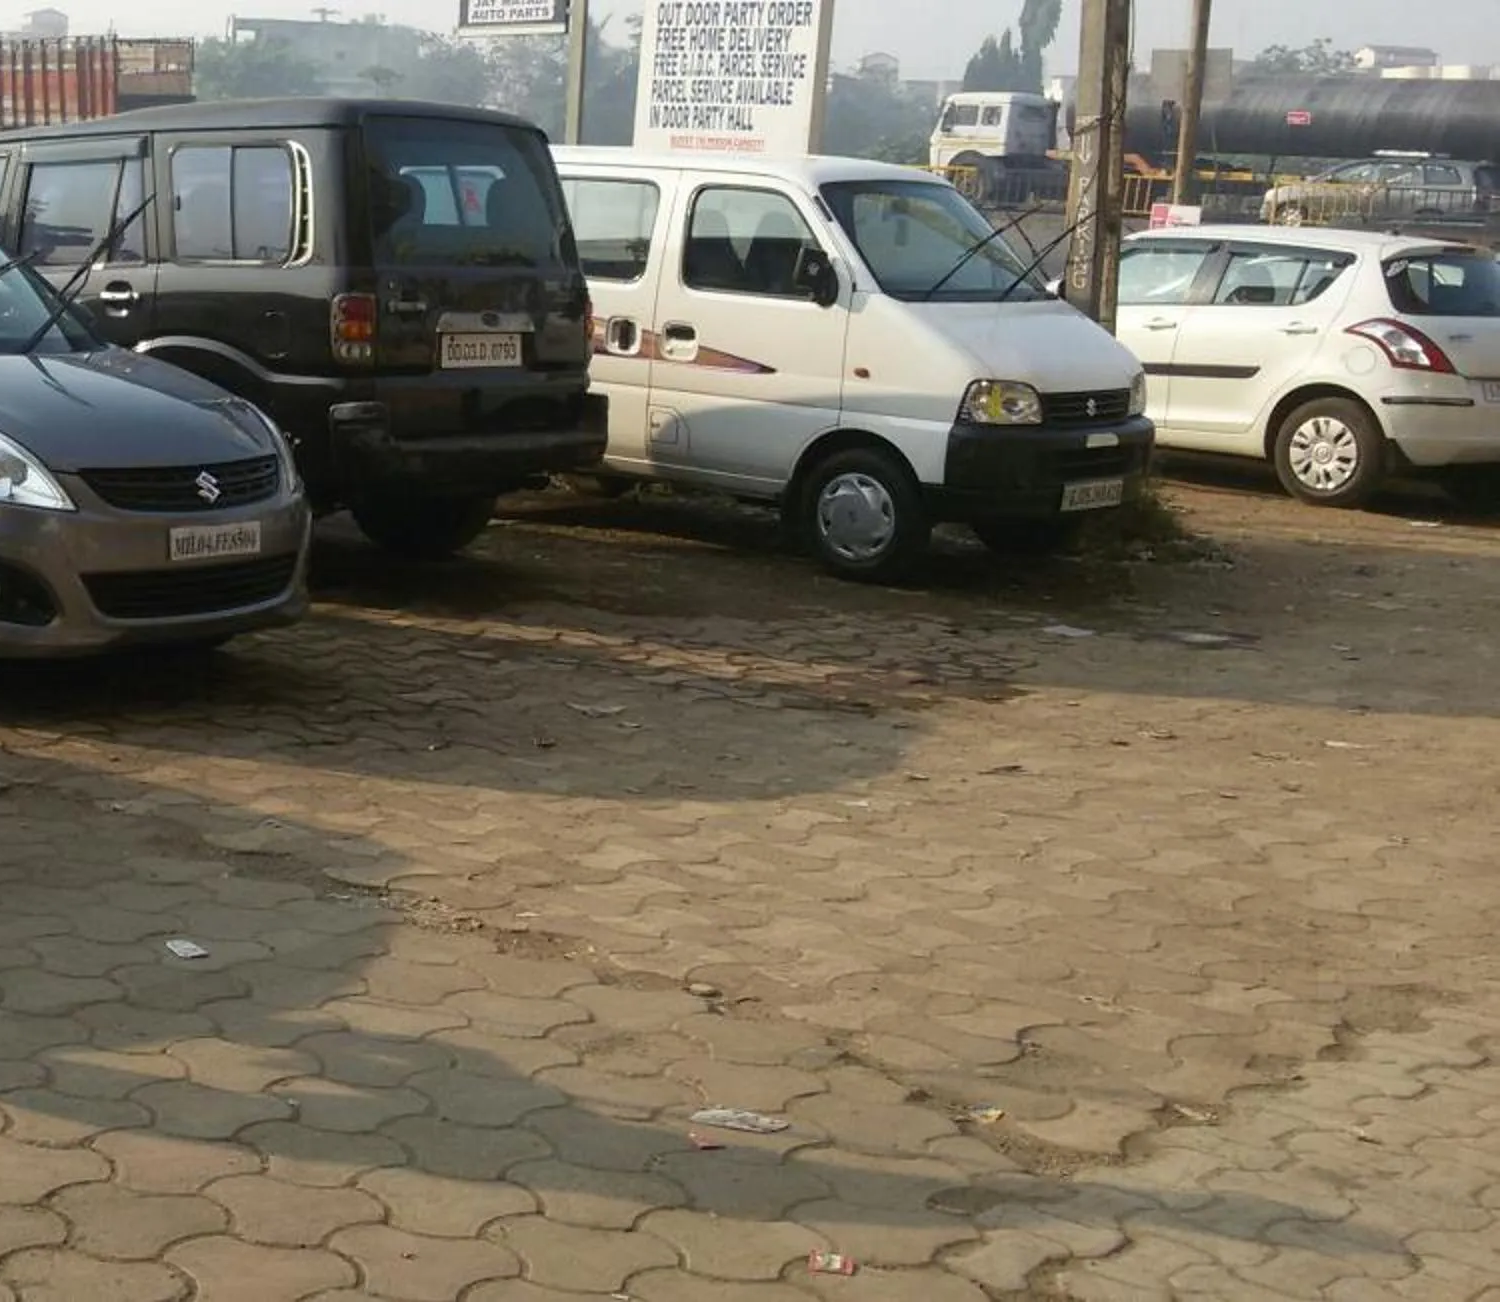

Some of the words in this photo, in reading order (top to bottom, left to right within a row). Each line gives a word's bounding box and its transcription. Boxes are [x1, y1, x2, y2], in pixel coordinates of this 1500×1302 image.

[472, 9, 504, 19] AUTO
[509, 8, 549, 18] PARTS
[658, 2, 682, 26] OUT
[686, 2, 720, 26] DOOR
[723, 2, 765, 26] PARTY
[768, 2, 813, 26] ORDER
[656, 28, 686, 51] FREE
[690, 28, 725, 51] HOME
[729, 28, 793, 52] DELIVERY
[654, 53, 679, 76] FREE
[718, 54, 757, 77] PARCEL
[760, 54, 807, 78] SERVICE
[652, 80, 687, 103] PARCEL
[690, 80, 733, 104] SERVICE
[735, 81, 794, 105] AVAILABLE
[649, 106, 660, 128] IN
[662, 106, 690, 129] DOOR
[692, 106, 725, 129] PARTY
[726, 107, 753, 130] HALL
